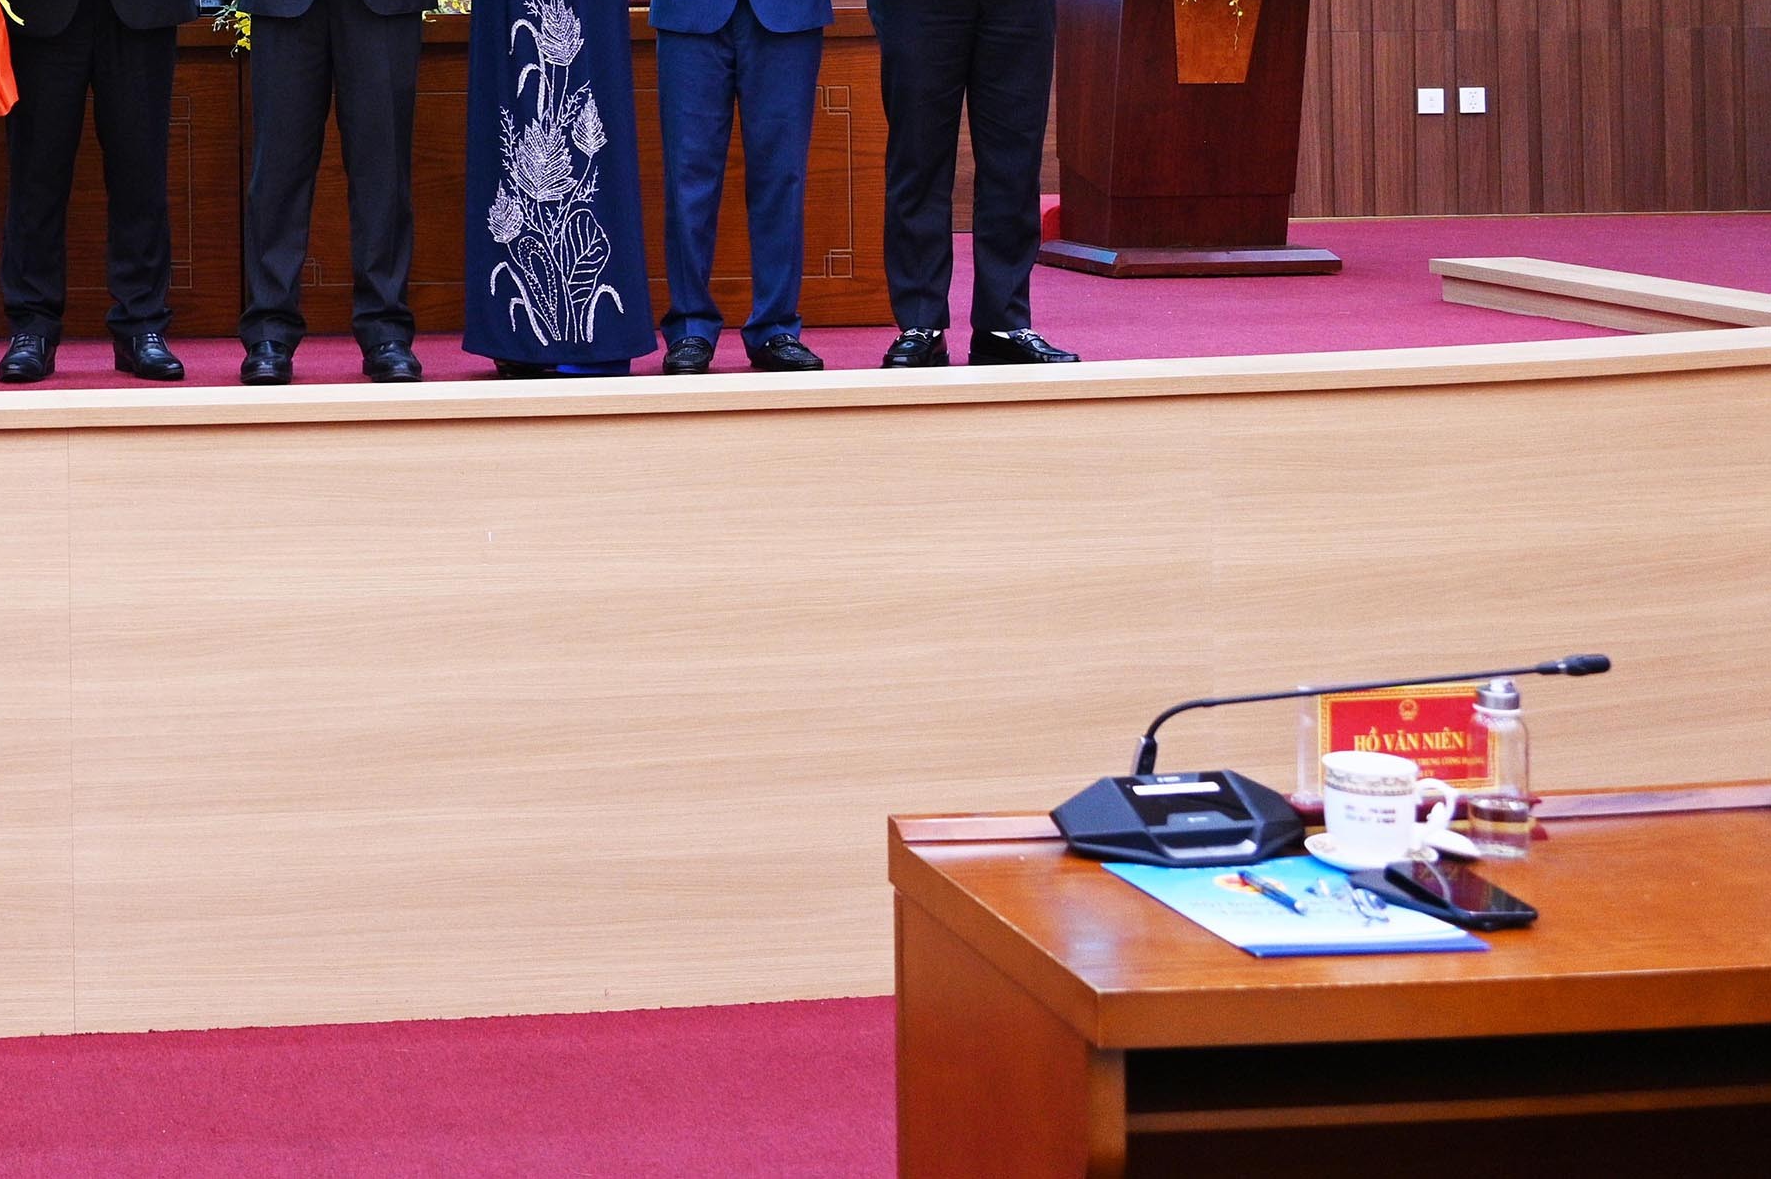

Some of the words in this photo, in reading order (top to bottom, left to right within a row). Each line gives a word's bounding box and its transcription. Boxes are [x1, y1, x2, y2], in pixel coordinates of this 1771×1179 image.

[1354, 726, 1381, 752] HỒ
[1383, 729, 1419, 751] VĂN
[1423, 726, 1465, 750] NIÊN
